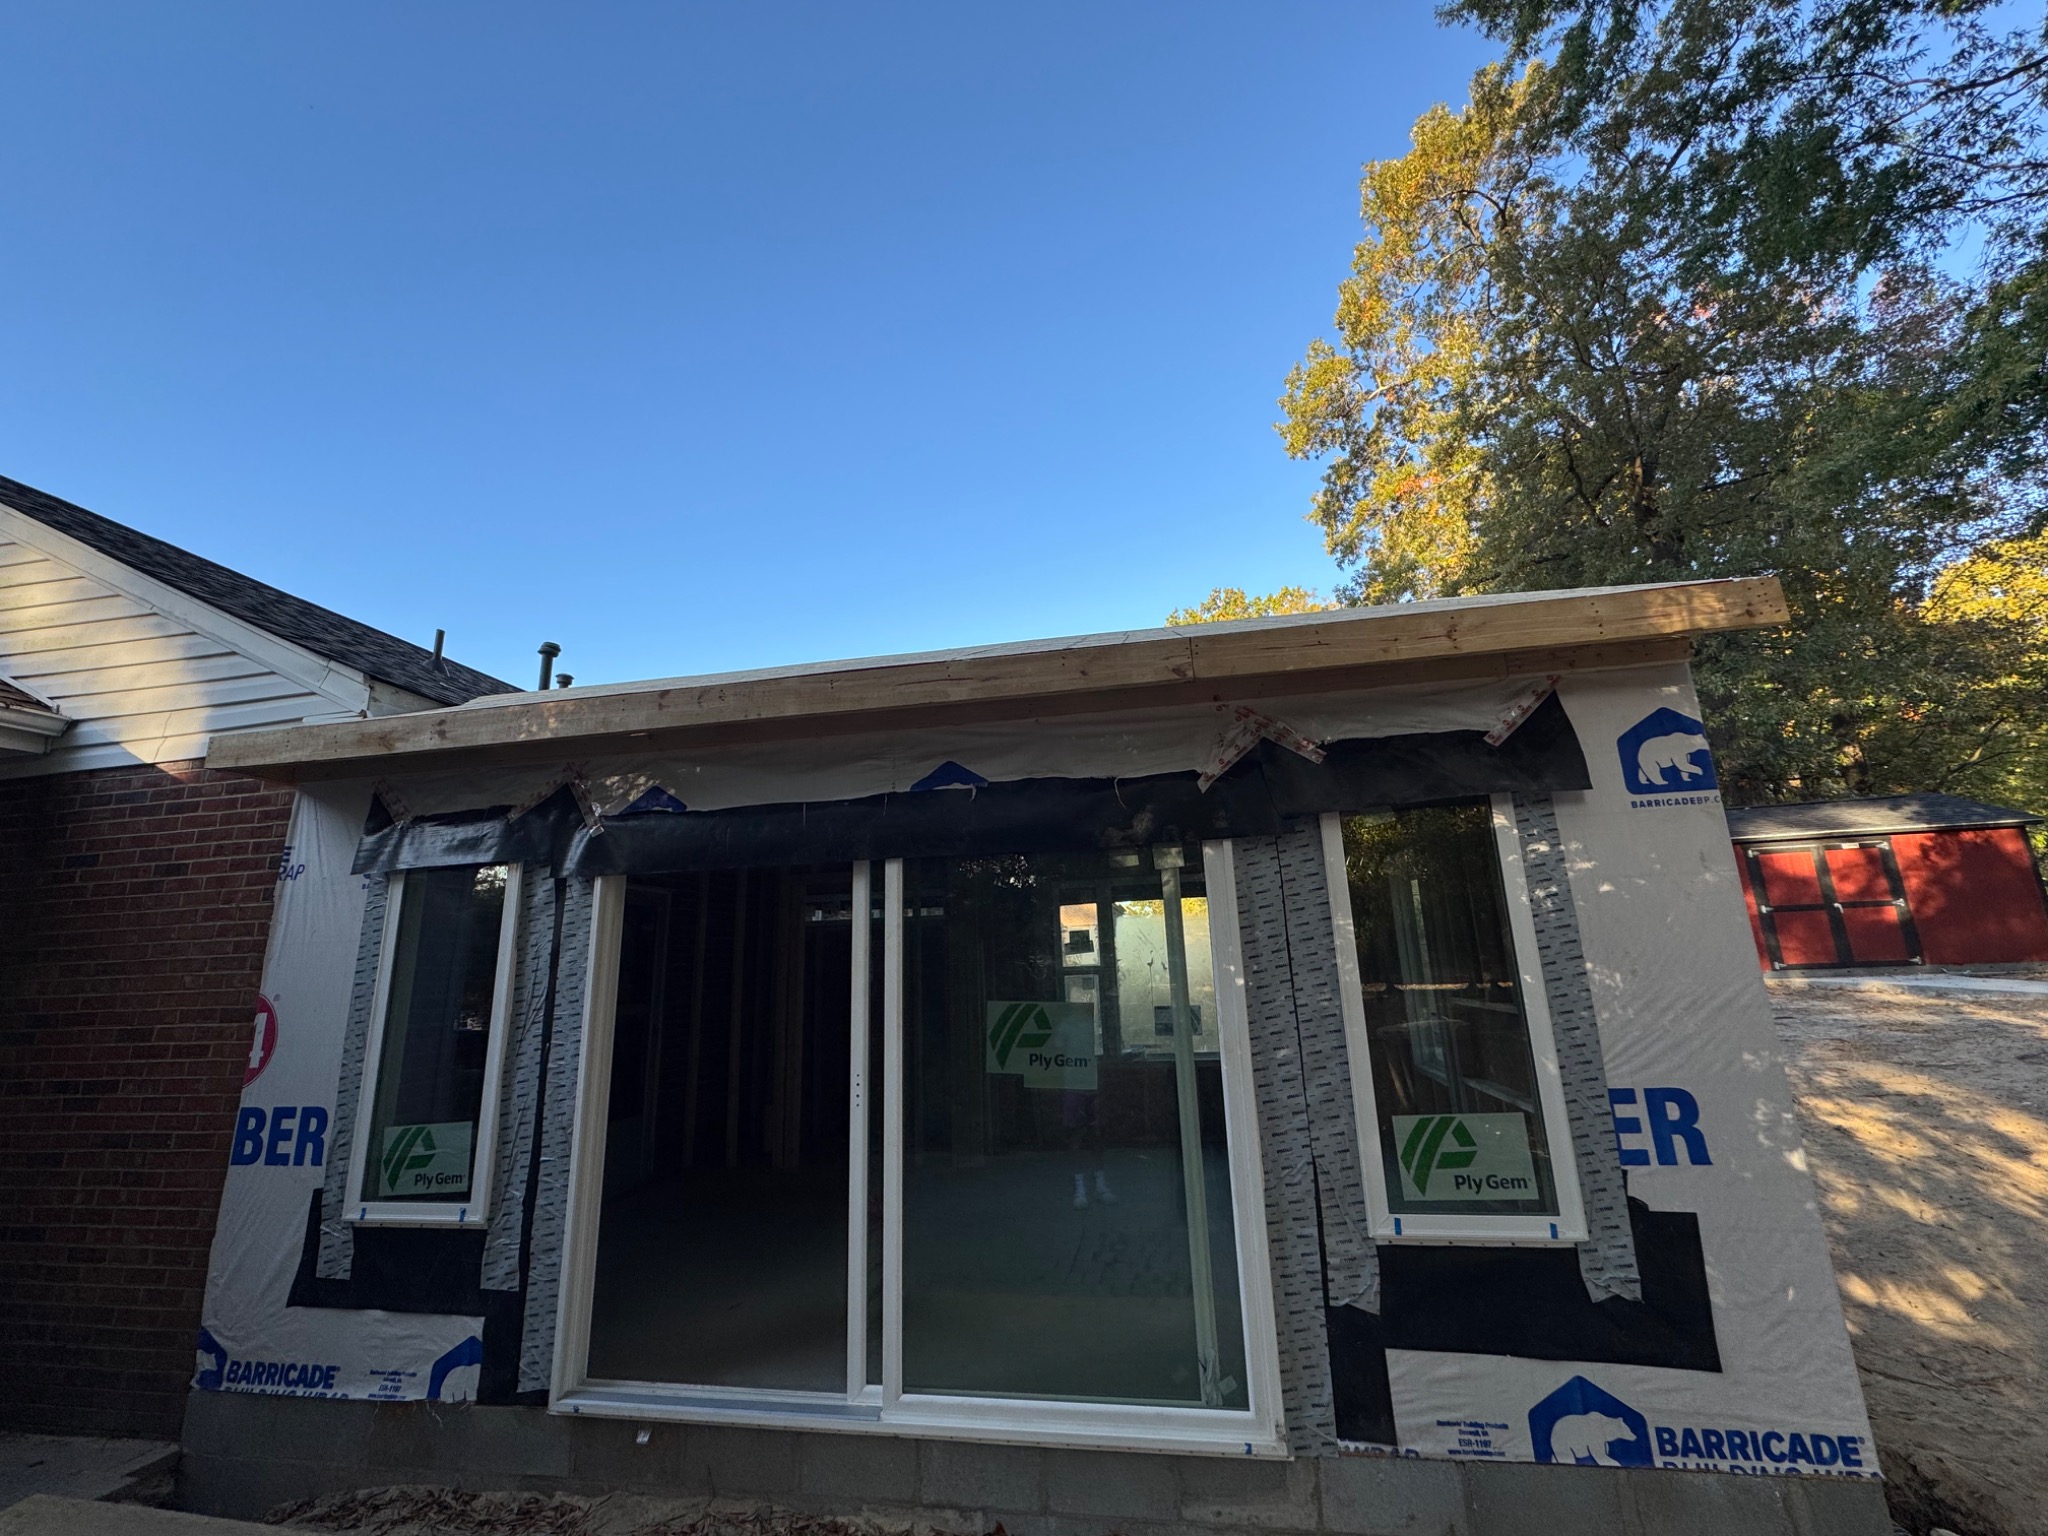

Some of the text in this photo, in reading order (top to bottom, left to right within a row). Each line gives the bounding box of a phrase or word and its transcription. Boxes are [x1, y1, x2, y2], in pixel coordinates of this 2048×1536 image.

[1029, 1053, 1088, 1071] Ply Gem
[231, 1106, 328, 1166] BER
[1608, 1087, 1713, 1166] ER
[414, 1171, 463, 1189] Ply Gem
[1454, 1173, 1529, 1195] Ply Gem
[226, 1360, 337, 1390] BARRICADE
[1654, 1426, 1864, 1468] BARRICADE
